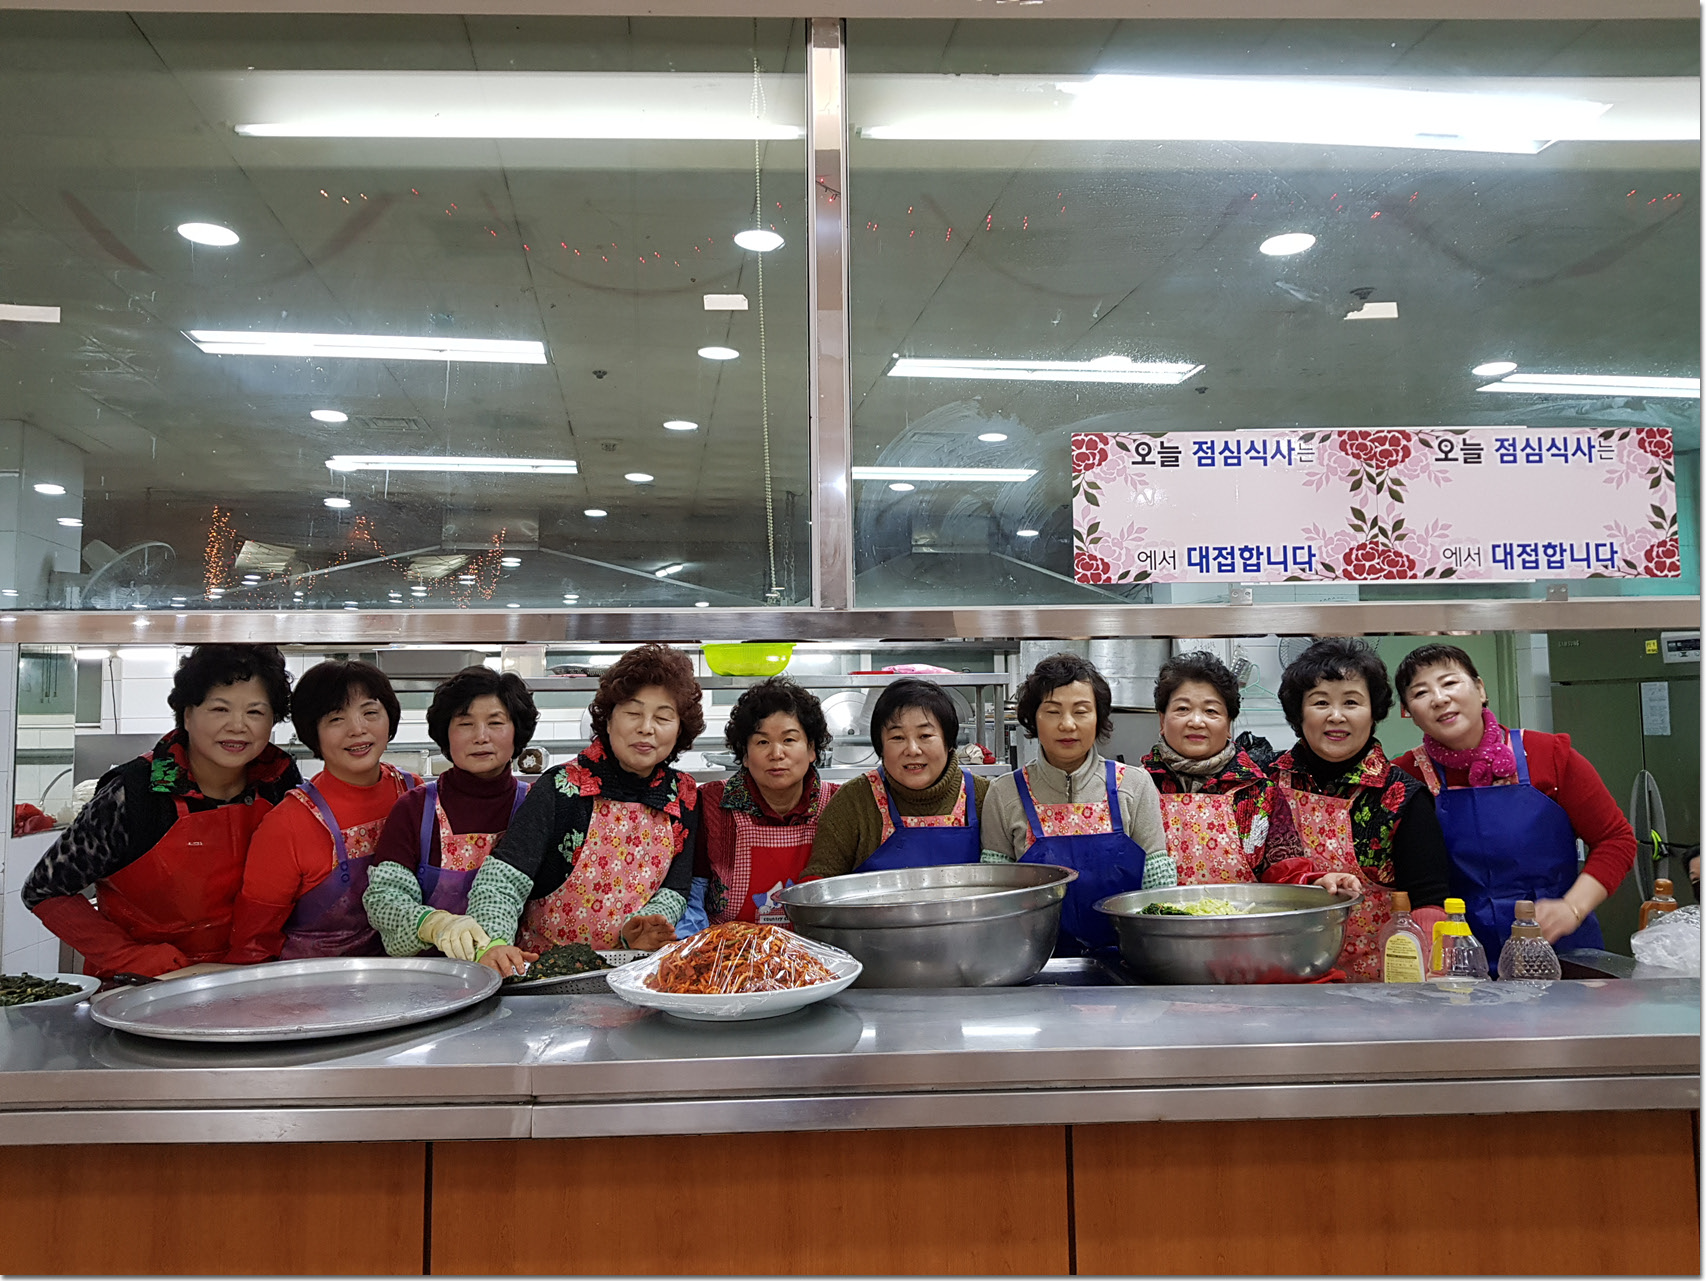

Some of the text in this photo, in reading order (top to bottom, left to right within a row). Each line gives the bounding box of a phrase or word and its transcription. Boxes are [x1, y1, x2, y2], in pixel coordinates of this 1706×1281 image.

[1131, 439, 1316, 467] 오늘 점심식사는
[1434, 436, 1615, 464] 오늘 점심식사는
[1137, 544, 1317, 573] 에서 대접합니다
[1442, 541, 1618, 570] 에서 대접합니다
